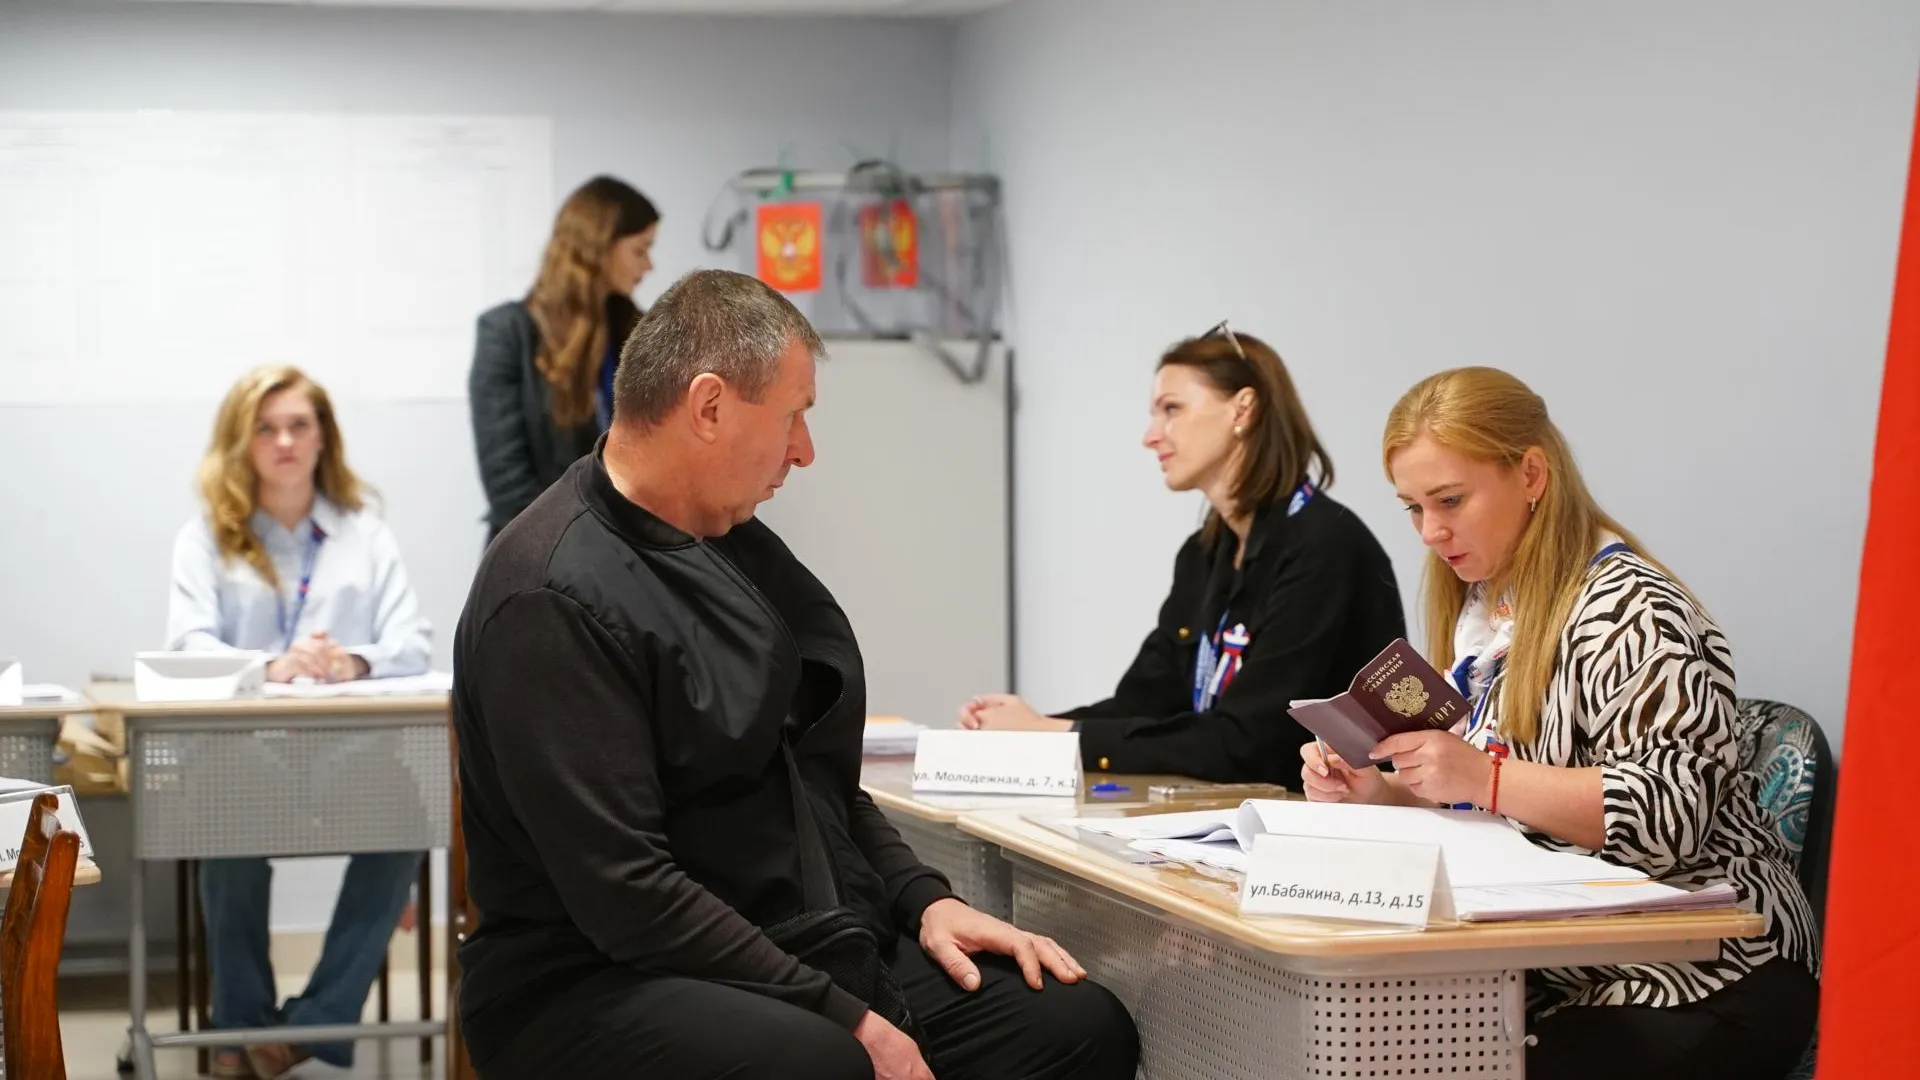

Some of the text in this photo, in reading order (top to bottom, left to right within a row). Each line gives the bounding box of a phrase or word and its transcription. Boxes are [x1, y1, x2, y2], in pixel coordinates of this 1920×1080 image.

[1362, 652, 1401, 691] РОССИЙСКАЯ
[1428, 700, 1456, 727] ПОРТ
[913, 771, 931, 783] ул.
[935, 771, 1023, 787] Молодежная,
[1026, 777, 1038, 788] д.
[1250, 883, 1424, 910] ул.Бабакина, д.13, д.15
